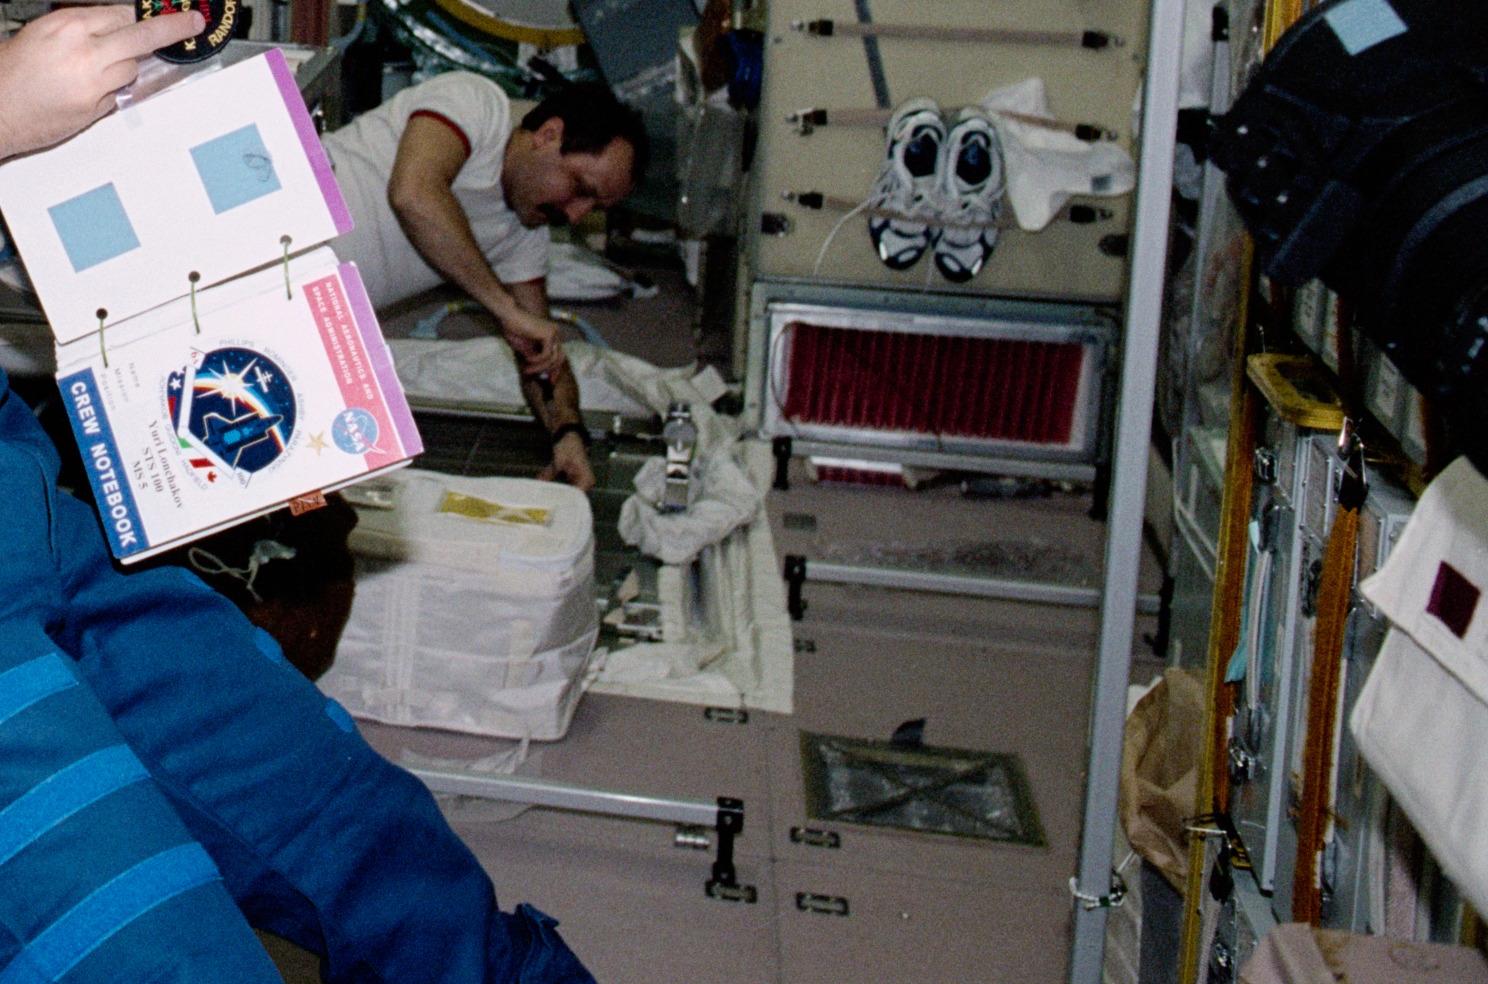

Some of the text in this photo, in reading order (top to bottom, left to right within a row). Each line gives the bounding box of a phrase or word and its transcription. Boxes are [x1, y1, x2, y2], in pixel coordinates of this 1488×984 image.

[312, 286, 353, 385] SPACE ADMINISTRATION
[325, 281, 374, 401] NATIONAL AERONAUTICS AND
[100, 373, 116, 412] Position
[114, 367, 130, 404] Mission
[128, 362, 141, 389] Name
[343, 411, 366, 453] NASA
[70, 381, 138, 548] CREW NOTEBOOK
[132, 459, 148, 491] MS 5
[142, 446, 164, 494] STS 100
[148, 419, 184, 509] Yuri Lonchakov
